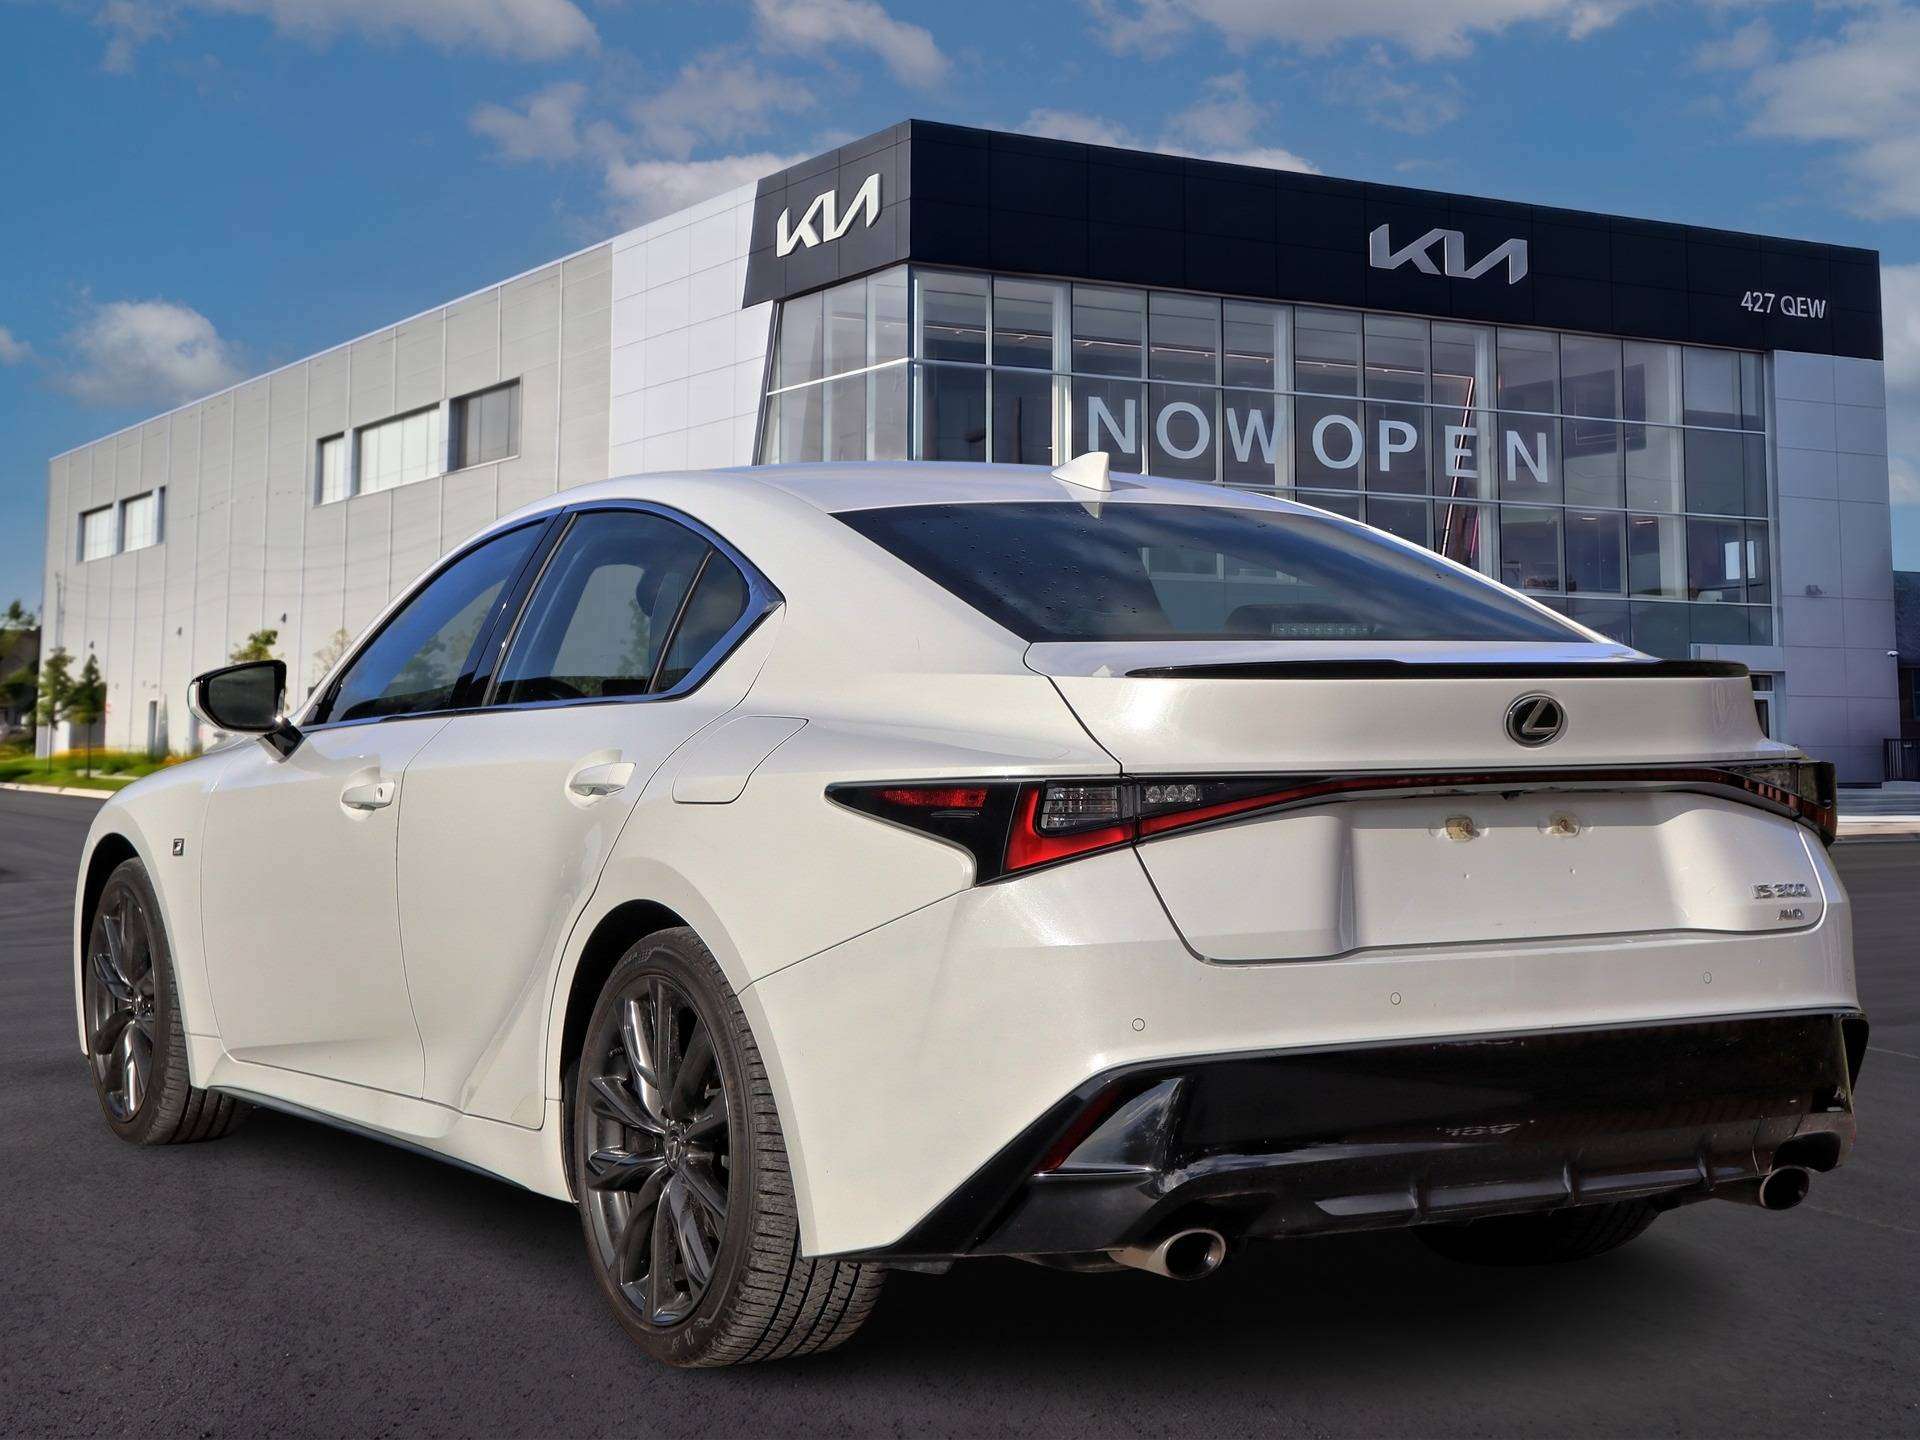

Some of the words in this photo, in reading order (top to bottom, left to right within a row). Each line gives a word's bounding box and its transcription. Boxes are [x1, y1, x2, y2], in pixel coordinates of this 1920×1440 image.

[776, 173, 881, 258] KIA
[1369, 223, 1528, 285] KIA
[1740, 291, 1776, 313] 427
[1780, 295, 1826, 319] QEW
[1088, 396, 1278, 464] NOW
[1312, 414, 1549, 483] OPEN
